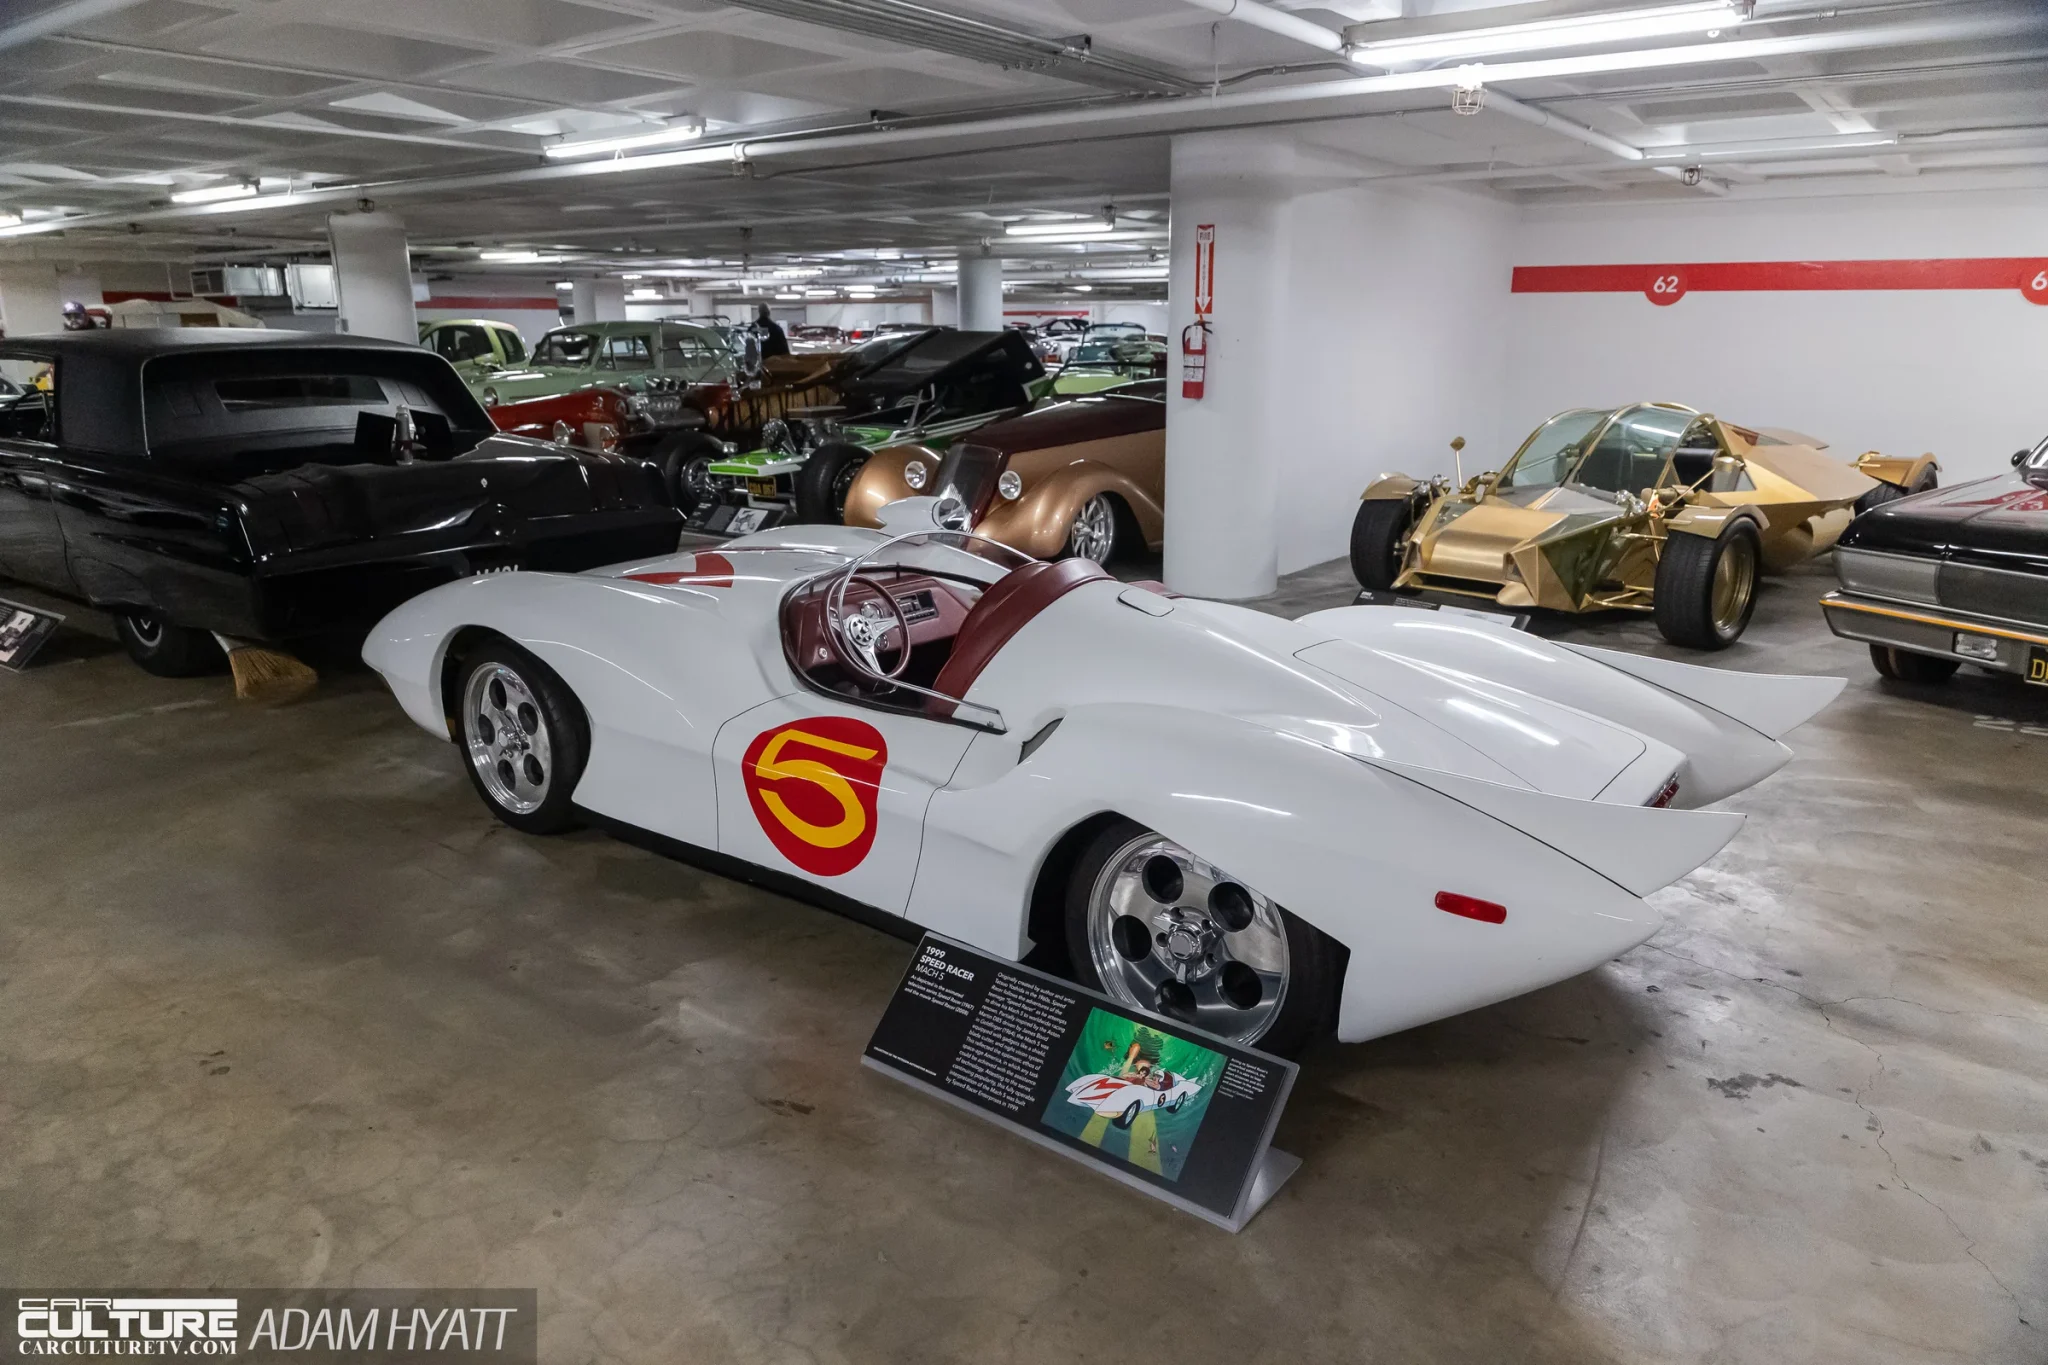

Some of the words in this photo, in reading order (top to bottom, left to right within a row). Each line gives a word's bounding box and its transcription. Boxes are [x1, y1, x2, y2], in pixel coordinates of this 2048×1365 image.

[1653, 276, 1679, 293] 62
[2031, 270, 2048, 291] 6
[755, 728, 879, 849] 5
[926, 946, 946, 959] 1999
[915, 963, 939, 978] MACH
[938, 972, 945, 981] 5
[920, 954, 946, 970] SPEED
[946, 964, 974, 981] RACER
